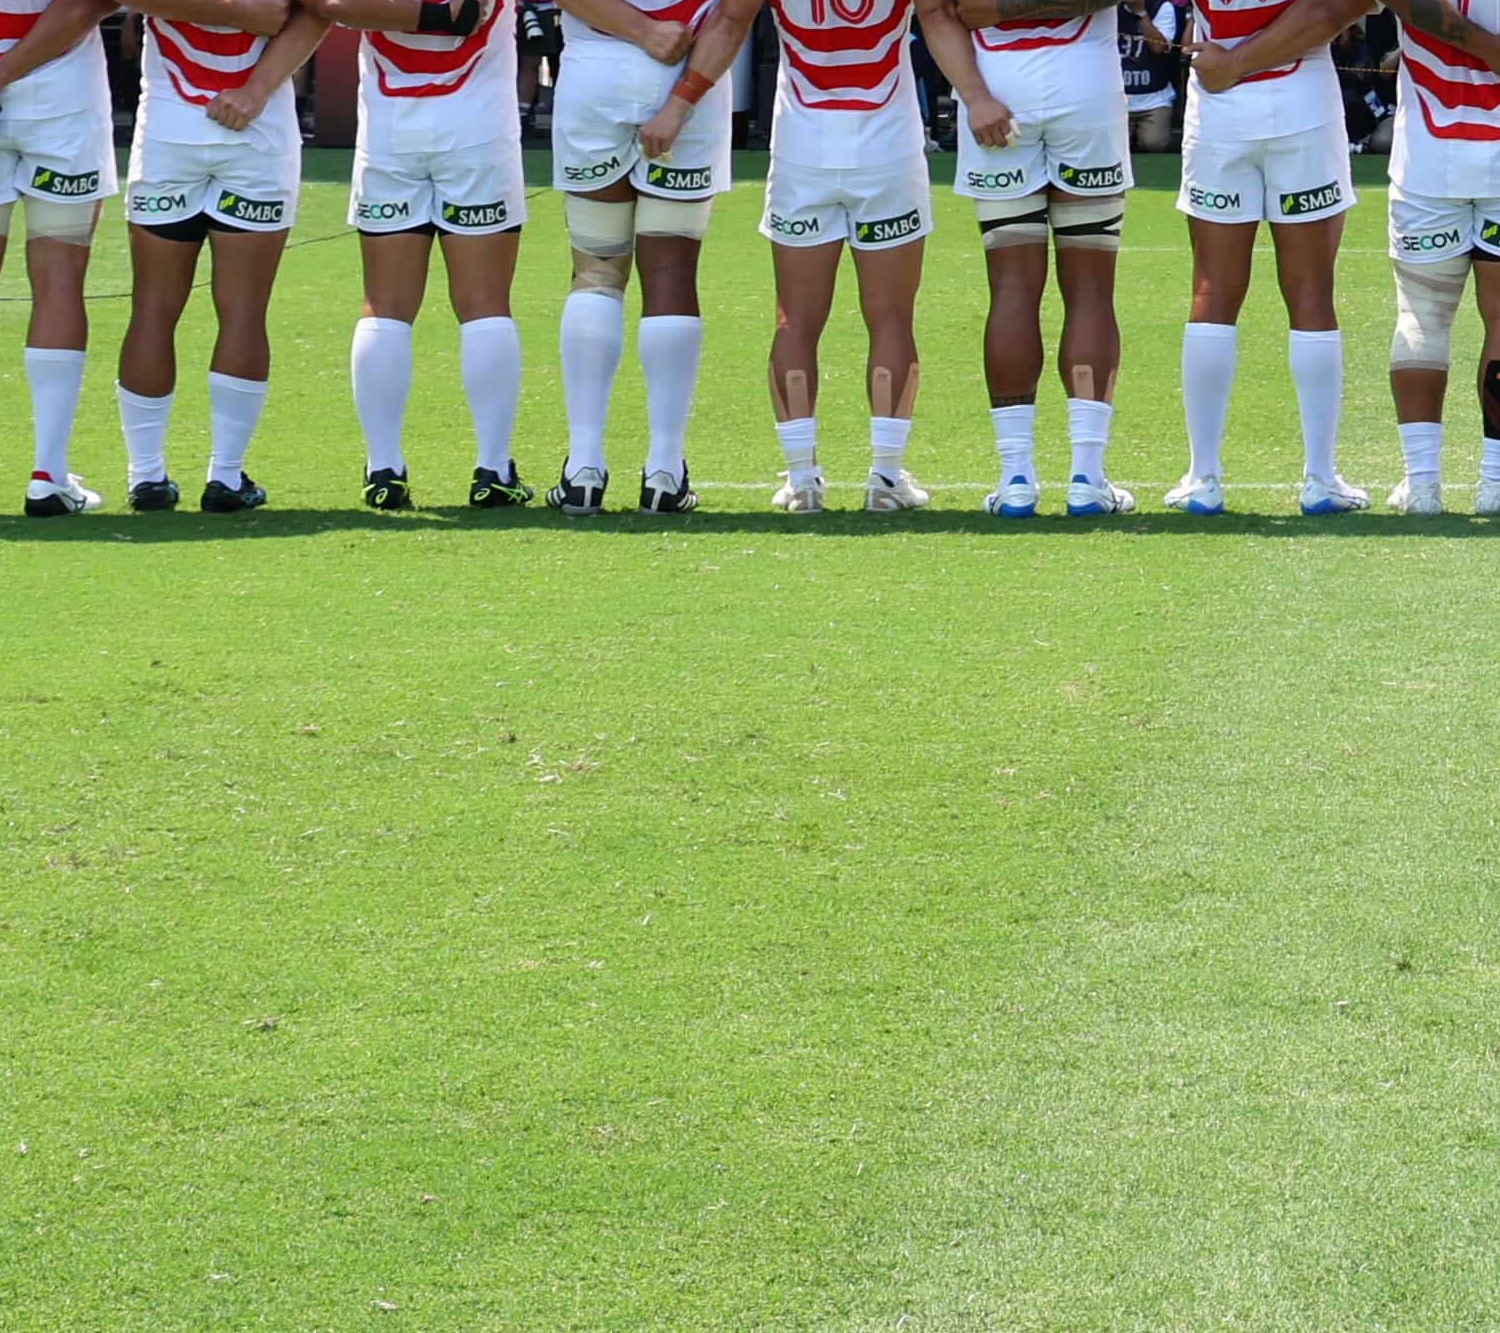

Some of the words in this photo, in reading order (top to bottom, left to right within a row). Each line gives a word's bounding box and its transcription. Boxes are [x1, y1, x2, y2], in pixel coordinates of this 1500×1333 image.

[565, 156, 620, 181] SECOM
[665, 169, 711, 190] SMBC
[968, 168, 1024, 189] SECOM
[1077, 165, 1123, 188] SMBC
[51, 174, 98, 194] SMBC
[133, 194, 186, 212] SECOM
[1190, 187, 1240, 210] SECOM
[1298, 184, 1341, 212] SMBC
[235, 201, 283, 222] SMBC
[357, 202, 409, 220] SECOM
[458, 203, 506, 225] SMBC
[770, 213, 819, 235] SECOM
[873, 212, 920, 241] SMBC
[1402, 228, 1460, 252] SECOM
